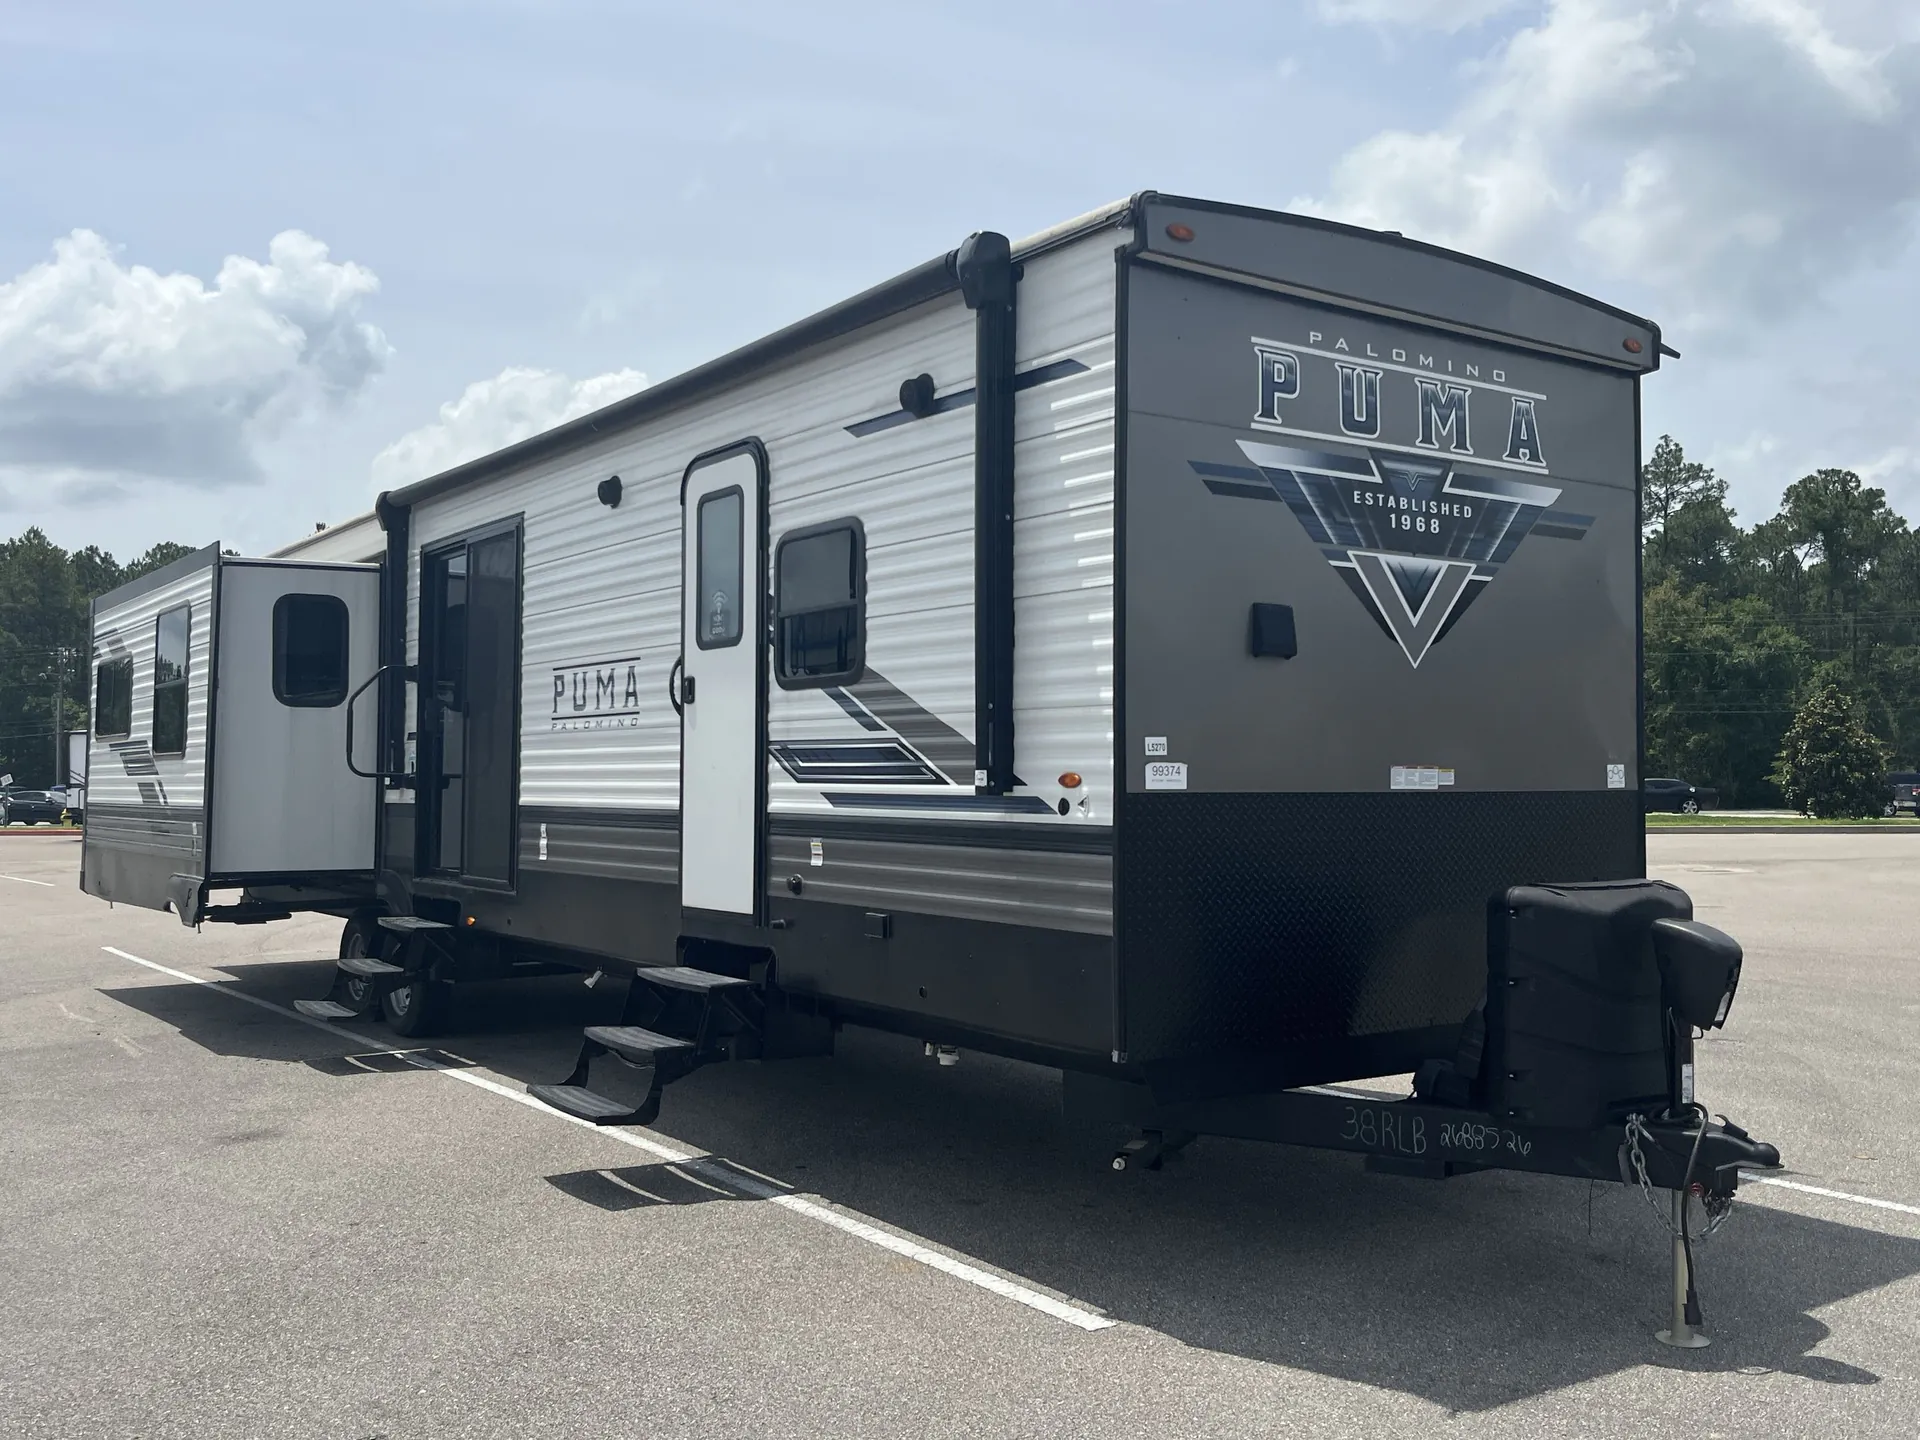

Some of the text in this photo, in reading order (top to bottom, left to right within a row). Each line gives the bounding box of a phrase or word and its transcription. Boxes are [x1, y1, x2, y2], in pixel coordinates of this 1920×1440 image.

[1309, 331, 1506, 382] PALOMINO
[1253, 345, 1548, 467] PUMA
[1353, 490, 1472, 518] ESTABLISHED
[1389, 513, 1440, 534] 1968
[552, 665, 639, 714] PUMA
[551, 717, 639, 731] PALOMINO
[1151, 765, 1181, 777] 99374
[1339, 1106, 1427, 1154] 38RLB
